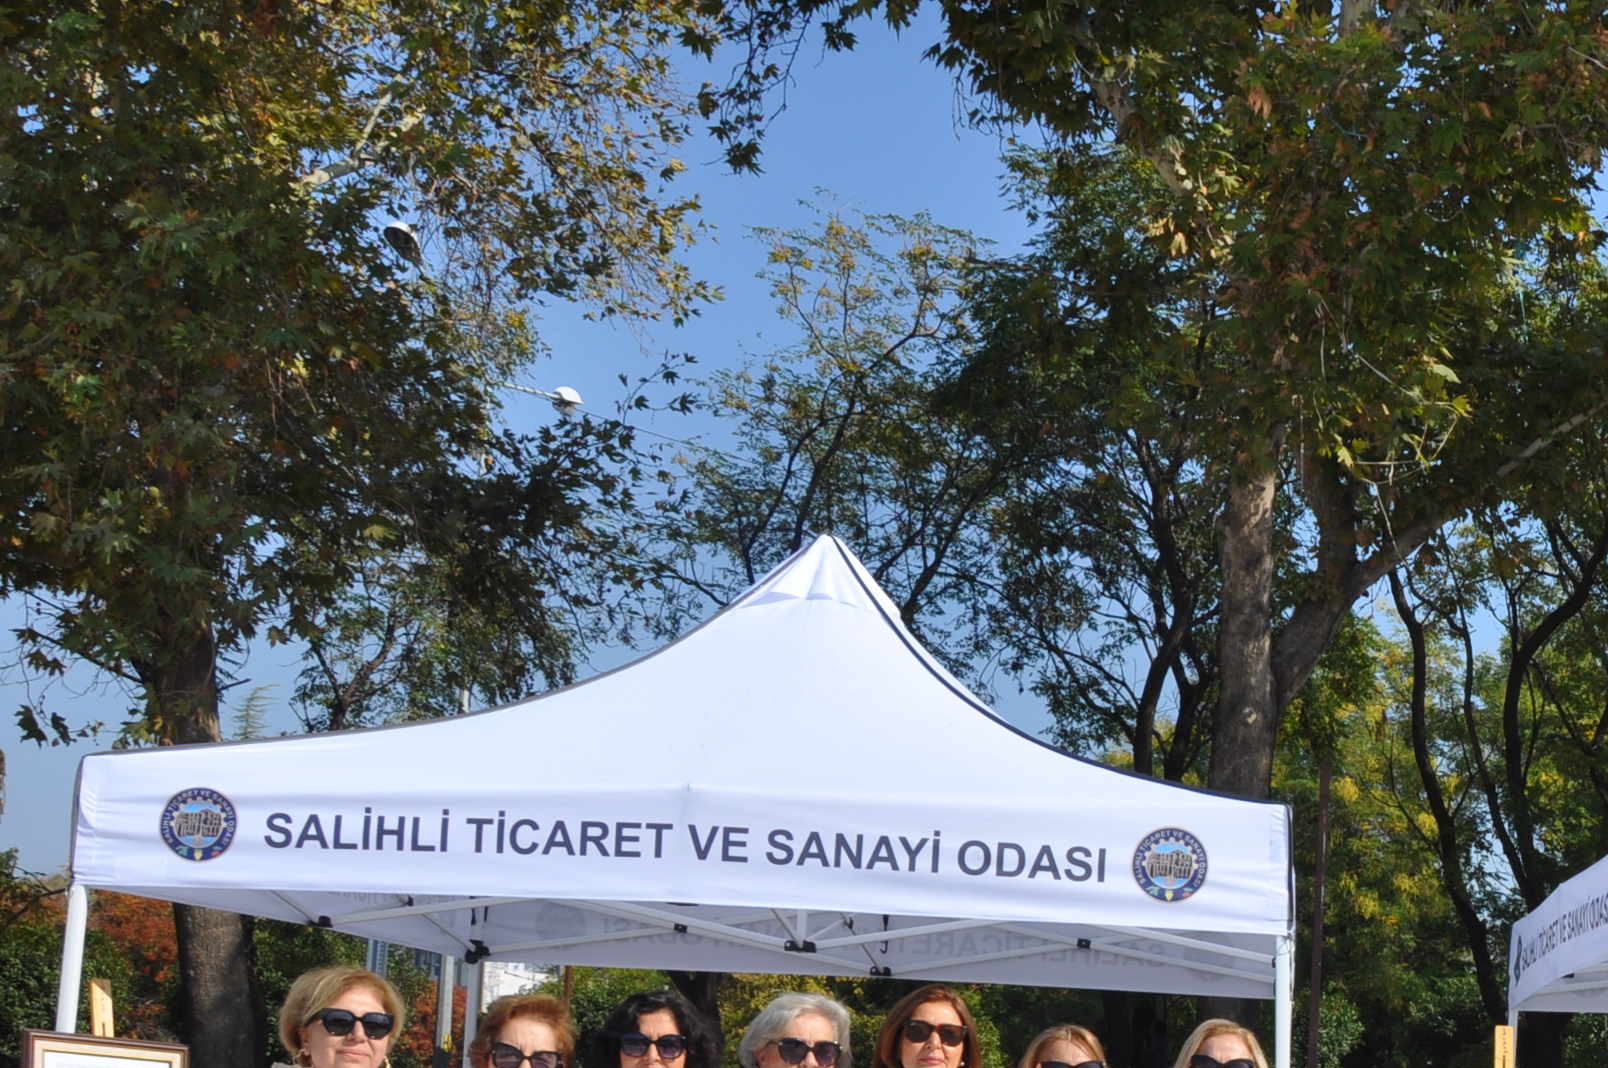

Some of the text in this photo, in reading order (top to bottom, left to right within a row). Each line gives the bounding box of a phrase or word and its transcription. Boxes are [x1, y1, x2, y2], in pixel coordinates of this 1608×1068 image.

[199, 789, 211, 798] VE
[220, 819, 235, 847] ODASI
[264, 807, 1106, 882] SALİHLİ TİCARET VE SANAYİ ODASI
[1172, 829, 1184, 839] VE
[1191, 861, 1205, 888] ODASI
